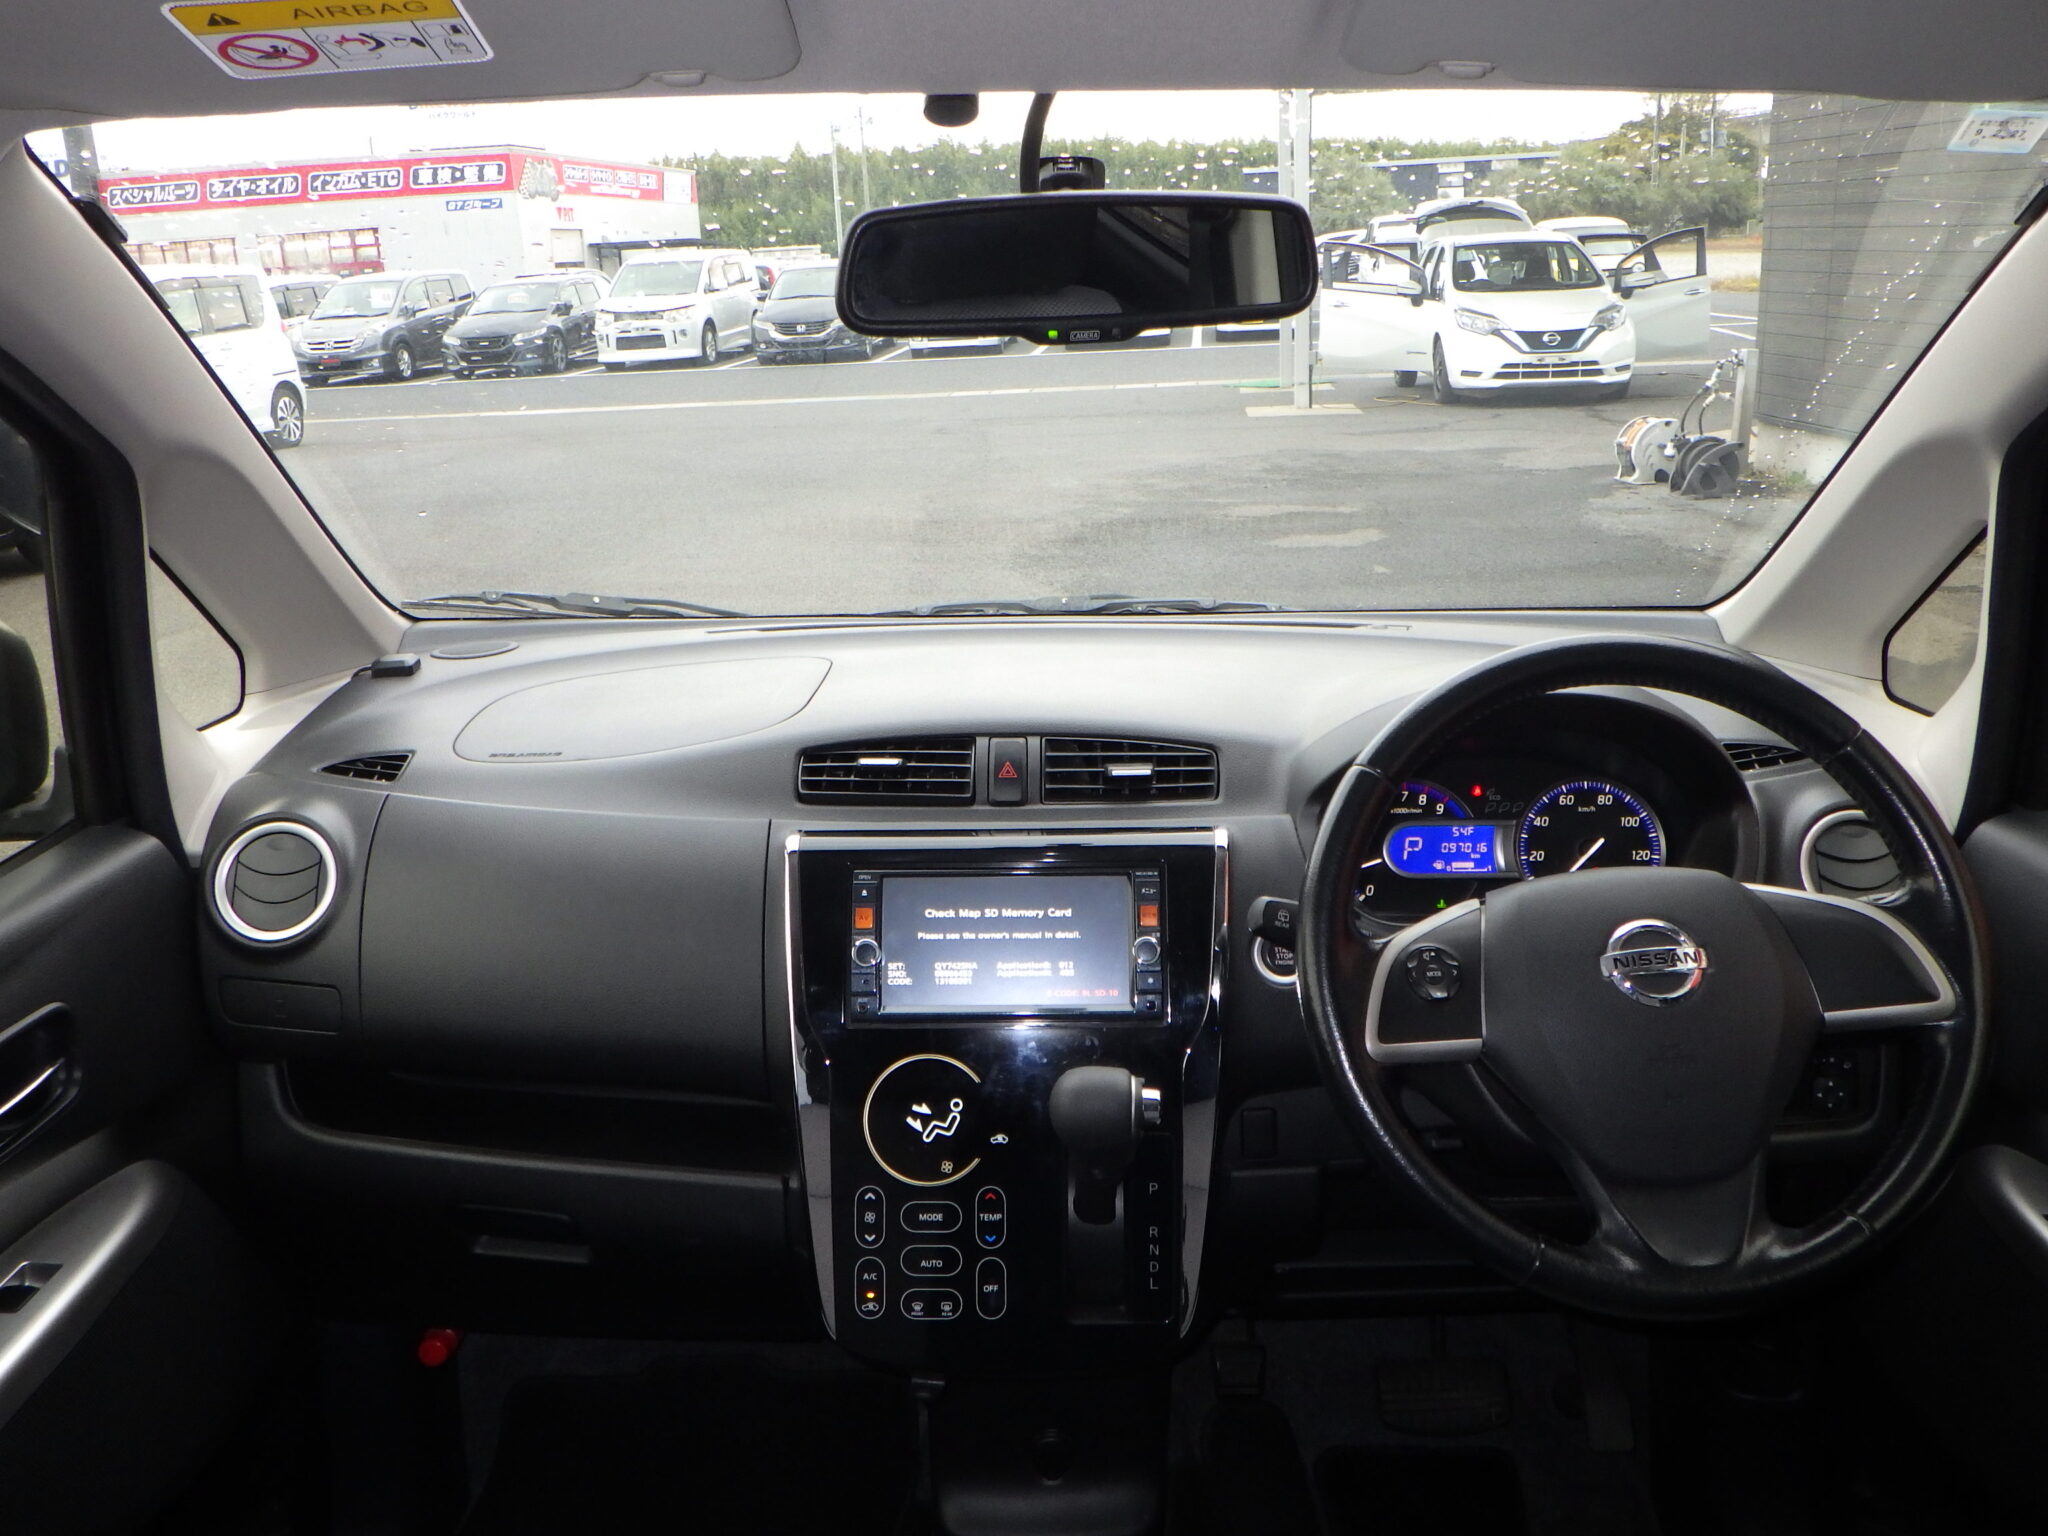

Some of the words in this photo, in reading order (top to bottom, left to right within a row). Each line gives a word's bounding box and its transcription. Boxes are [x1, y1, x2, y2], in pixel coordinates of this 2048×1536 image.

[293, 1, 429, 20] AIRBAG
[211, 177, 296, 198] タイヤ・オイル
[112, 184, 196, 206] スペシャルパーツ
[1401, 791, 1408, 802] 7
[1419, 794, 1427, 805] 8
[1559, 794, 1575, 806] 60
[1597, 794, 1613, 806] 80
[1436, 803, 1444, 815] 9
[1533, 816, 1549, 827] 40
[1621, 816, 1640, 828] 100
[1403, 837, 1423, 861] P
[1441, 842, 1488, 854] 097016
[1529, 850, 1545, 862] 20
[1632, 850, 1651, 861] 120
[1366, 885, 1375, 897] 0
[924, 908, 955, 918] Check
[958, 908, 981, 920] Map
[984, 908, 998, 918] SD
[1002, 907, 1044, 919] Memory
[1047, 906, 1072, 918] Card
[917, 932, 943, 940] Please
[963, 931, 976, 940] the
[978, 931, 1009, 940] owner's
[1012, 931, 1042, 940] manual
[1045, 931, 1053, 939] in
[1055, 931, 1081, 940] detail.
[887, 962, 905, 970] SET:
[1613, 951, 1698, 969] NISSAN
[1149, 1182, 1158, 1195] P
[919, 1213, 943, 1222] MODE
[979, 1213, 1003, 1222] TEMP
[1149, 1226, 1159, 1238] R
[1149, 1244, 1159, 1256] N
[920, 1260, 943, 1268] AUTO
[1149, 1261, 1159, 1273] D
[863, 1272, 878, 1281] A/C
[983, 1285, 999, 1293] OFF
[1150, 1277, 1159, 1290] L
